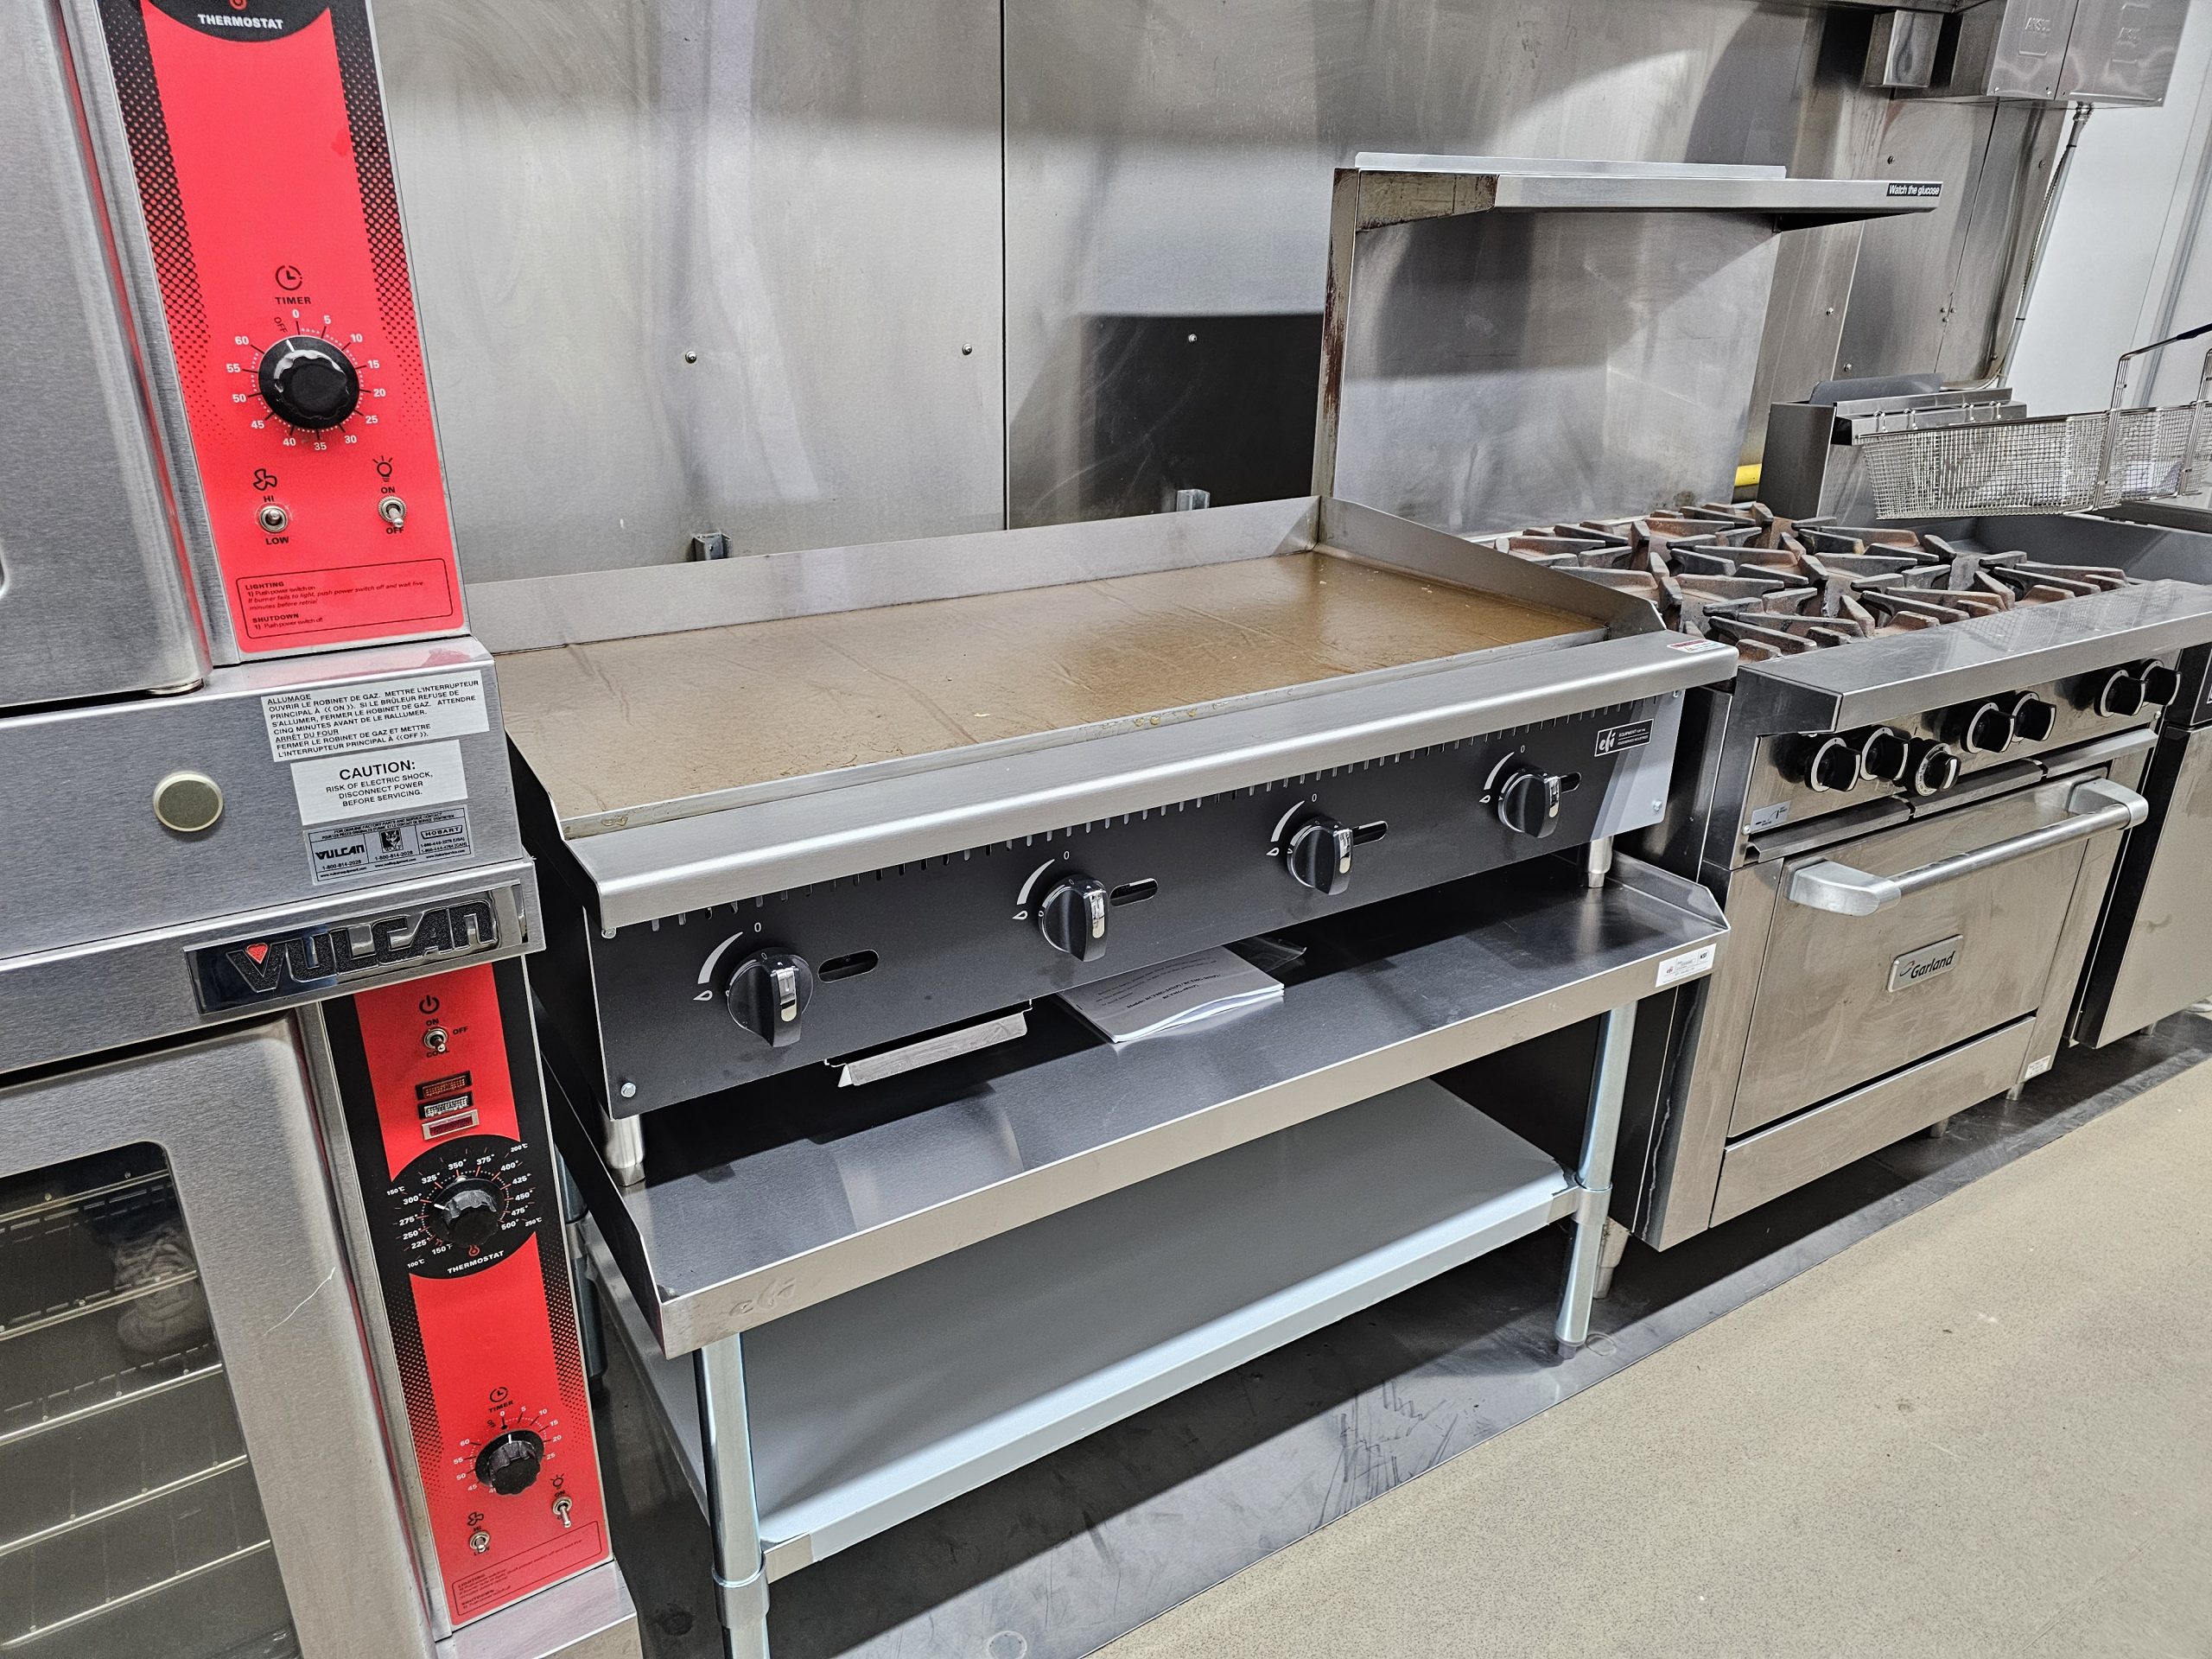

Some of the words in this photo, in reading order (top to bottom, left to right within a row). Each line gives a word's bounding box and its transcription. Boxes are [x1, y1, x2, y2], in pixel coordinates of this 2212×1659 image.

[197, 13, 283, 29] THERMOSTAT
[1889, 184, 1907, 194] Watch
[1908, 184, 1917, 194] the
[1917, 185, 1940, 196] glucose
[275, 296, 312, 305] TIMER
[292, 308, 300, 319] 0
[274, 316, 289, 333] OFF
[323, 315, 332, 325] 5
[234, 335, 249, 346] 60
[350, 334, 363, 343] 10
[226, 363, 241, 373] 55
[367, 359, 380, 369] 15
[232, 394, 247, 403] 50
[373, 389, 386, 397] 20
[251, 420, 265, 429] 45
[365, 416, 378, 424] 25
[283, 437, 296, 447] 40
[344, 435, 357, 444] 30
[314, 442, 327, 451] 35
[265, 537, 289, 545] LOW
[245, 582, 284, 590] LIGHTING
[252, 613, 299, 623] SHUTDOWN
[267, 694, 311, 705] ALLUMAGE
[269, 703, 299, 712] OUVRIR
[313, 696, 348, 707] ROBINET
[385, 688, 415, 697] METTRE
[416, 680, 479, 693] L'INTERRUPTEUR
[270, 710, 313, 720] PRINCIPAL
[380, 695, 416, 705] BRÛLEUR
[418, 691, 447, 700] REFUSE
[271, 716, 319, 728] S'ALLUMER,
[320, 712, 353, 721] FERMER
[366, 706, 400, 715] ROBINET
[437, 696, 476, 706] ATTENDRE
[296, 721, 332, 732] MINUTES
[334, 718, 359, 727] AVANT
[384, 709, 428, 720] RALLUMER.
[276, 733, 302, 743] ARRÊT
[316, 728, 339, 737] FOUR
[276, 741, 309, 750] FERMER
[323, 734, 358, 743] ROBINET
[400, 723, 431, 733] METTRE
[278, 743, 344, 758] L'INTERRUPTEUR
[346, 738, 387, 748] PRINCIPAL
[339, 760, 416, 780] CAUTION:
[326, 785, 345, 793] RISK
[360, 776, 400, 787] ELECTRIC
[339, 785, 391, 799] DISCONNECT
[394, 780, 423, 790] POWER
[342, 797, 375, 807] BEFORE
[377, 789, 423, 802] SERVICING.
[424, 827, 460, 837] HOBART
[315, 844, 365, 861] VULCAN
[226, 899, 500, 993] VULCAN
[1910, 950, 1955, 979] Garland
[453, 1026, 468, 1035] OFF
[448, 1250, 505, 1274] THERMOSTAT
[488, 1400, 513, 1413] TIMER
[453, 1456, 463, 1465] 55
[546, 1452, 556, 1460] 25
[456, 1472, 466, 1481] 50
